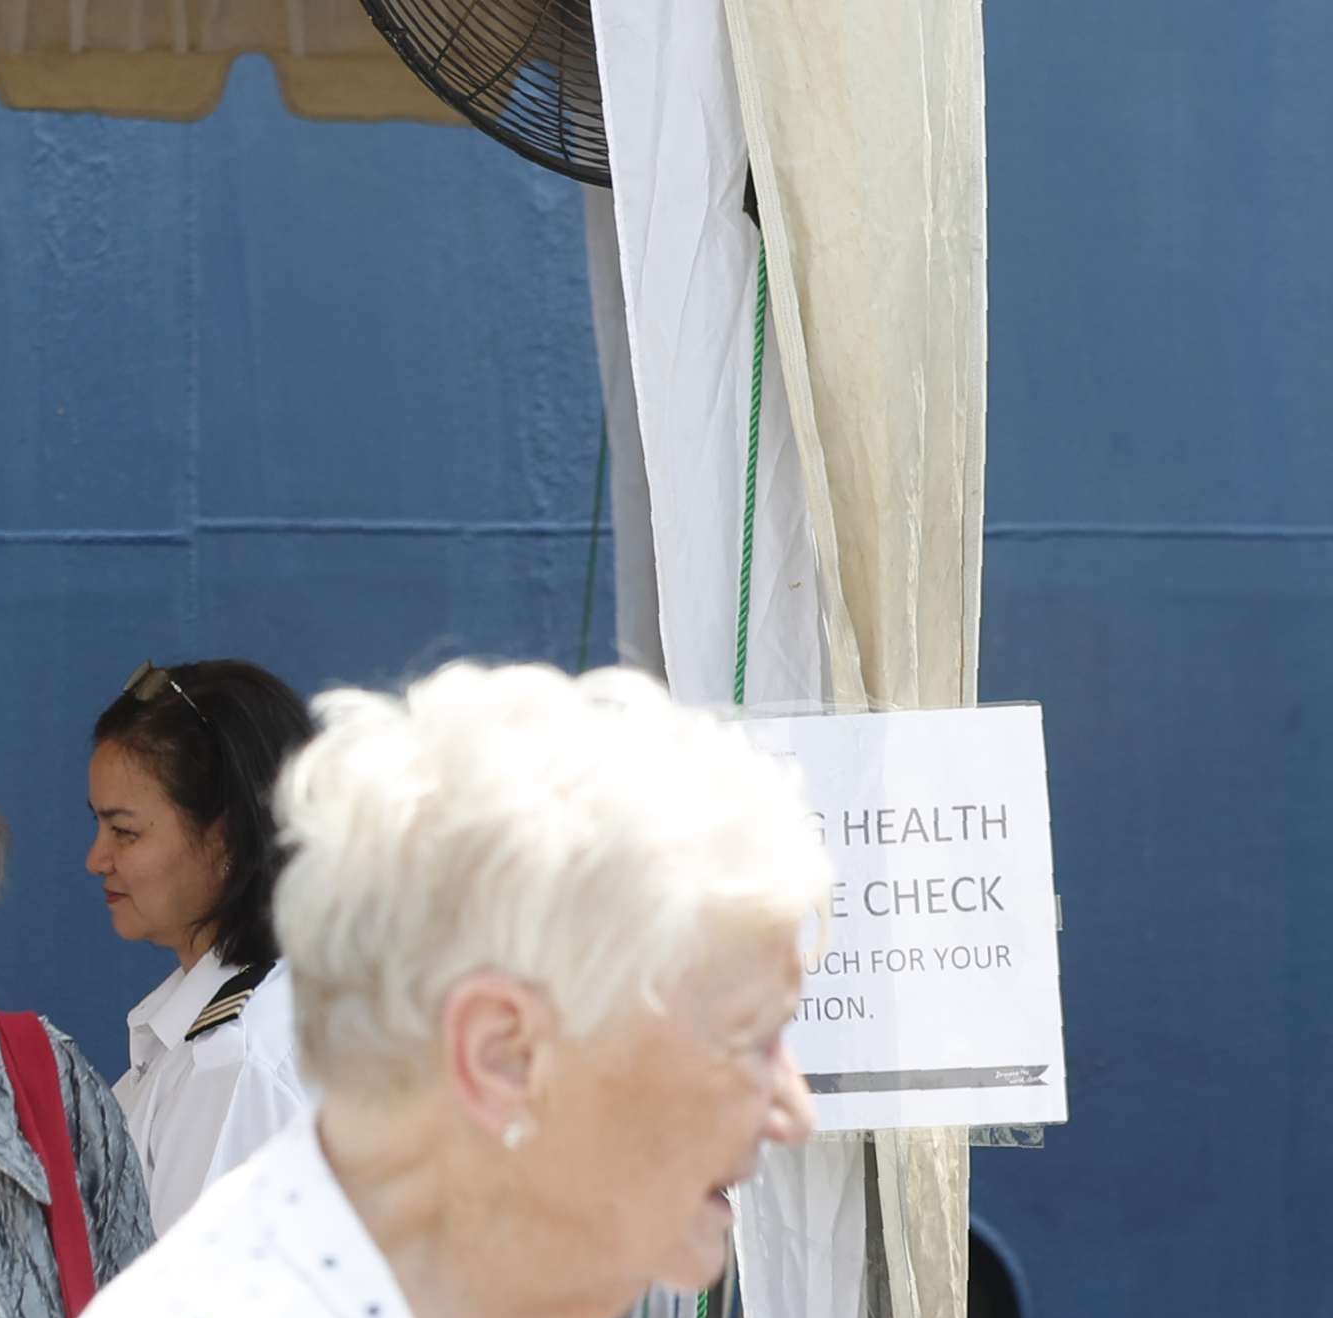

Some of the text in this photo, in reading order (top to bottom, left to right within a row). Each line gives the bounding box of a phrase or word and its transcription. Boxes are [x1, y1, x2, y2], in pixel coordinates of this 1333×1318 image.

[843, 804, 1008, 846] HEALTH
[863, 875, 1005, 917] CHECK
[804, 945, 1012, 976] UCH FOR YOUR
